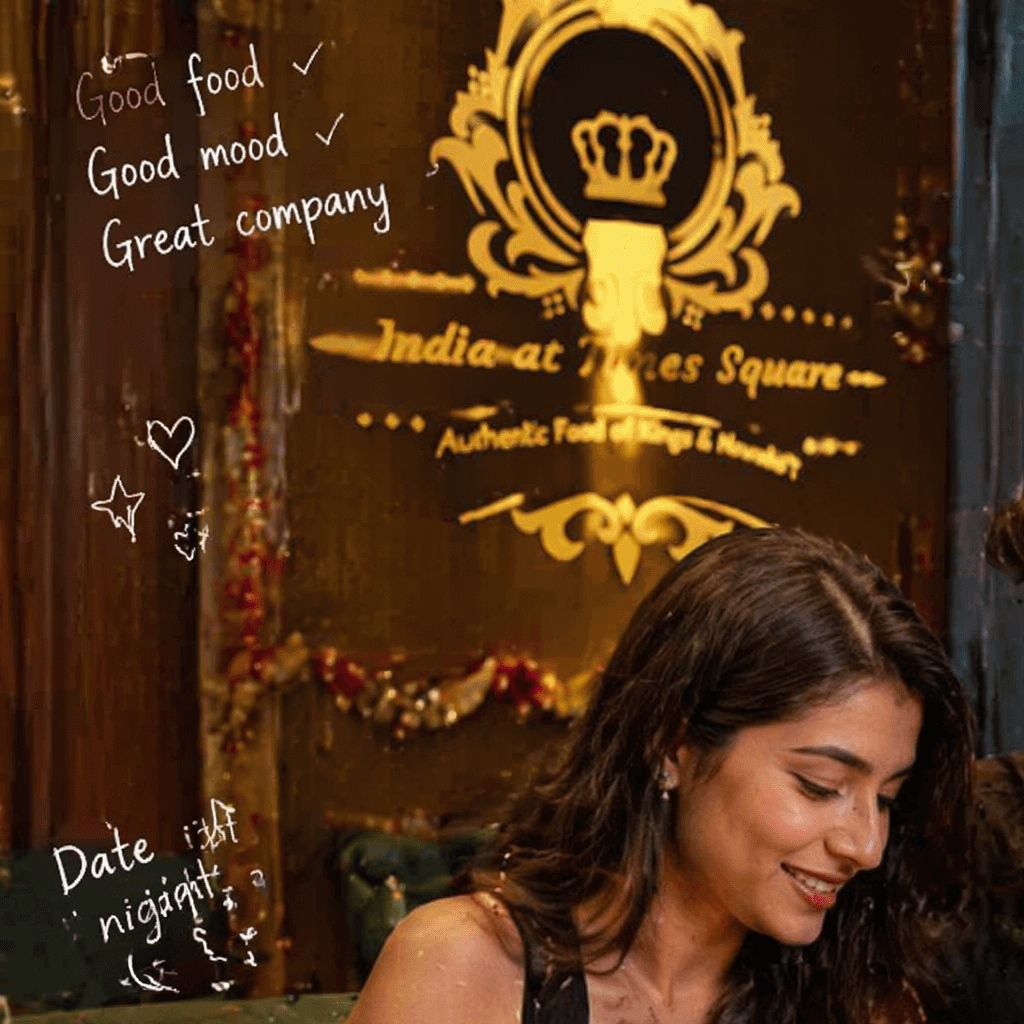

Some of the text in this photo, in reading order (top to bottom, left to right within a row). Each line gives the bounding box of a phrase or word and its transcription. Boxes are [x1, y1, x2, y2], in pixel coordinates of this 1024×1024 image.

[376, 319, 499, 367] India
[512, 339, 563, 373] at
[716, 345, 844, 398] Square
